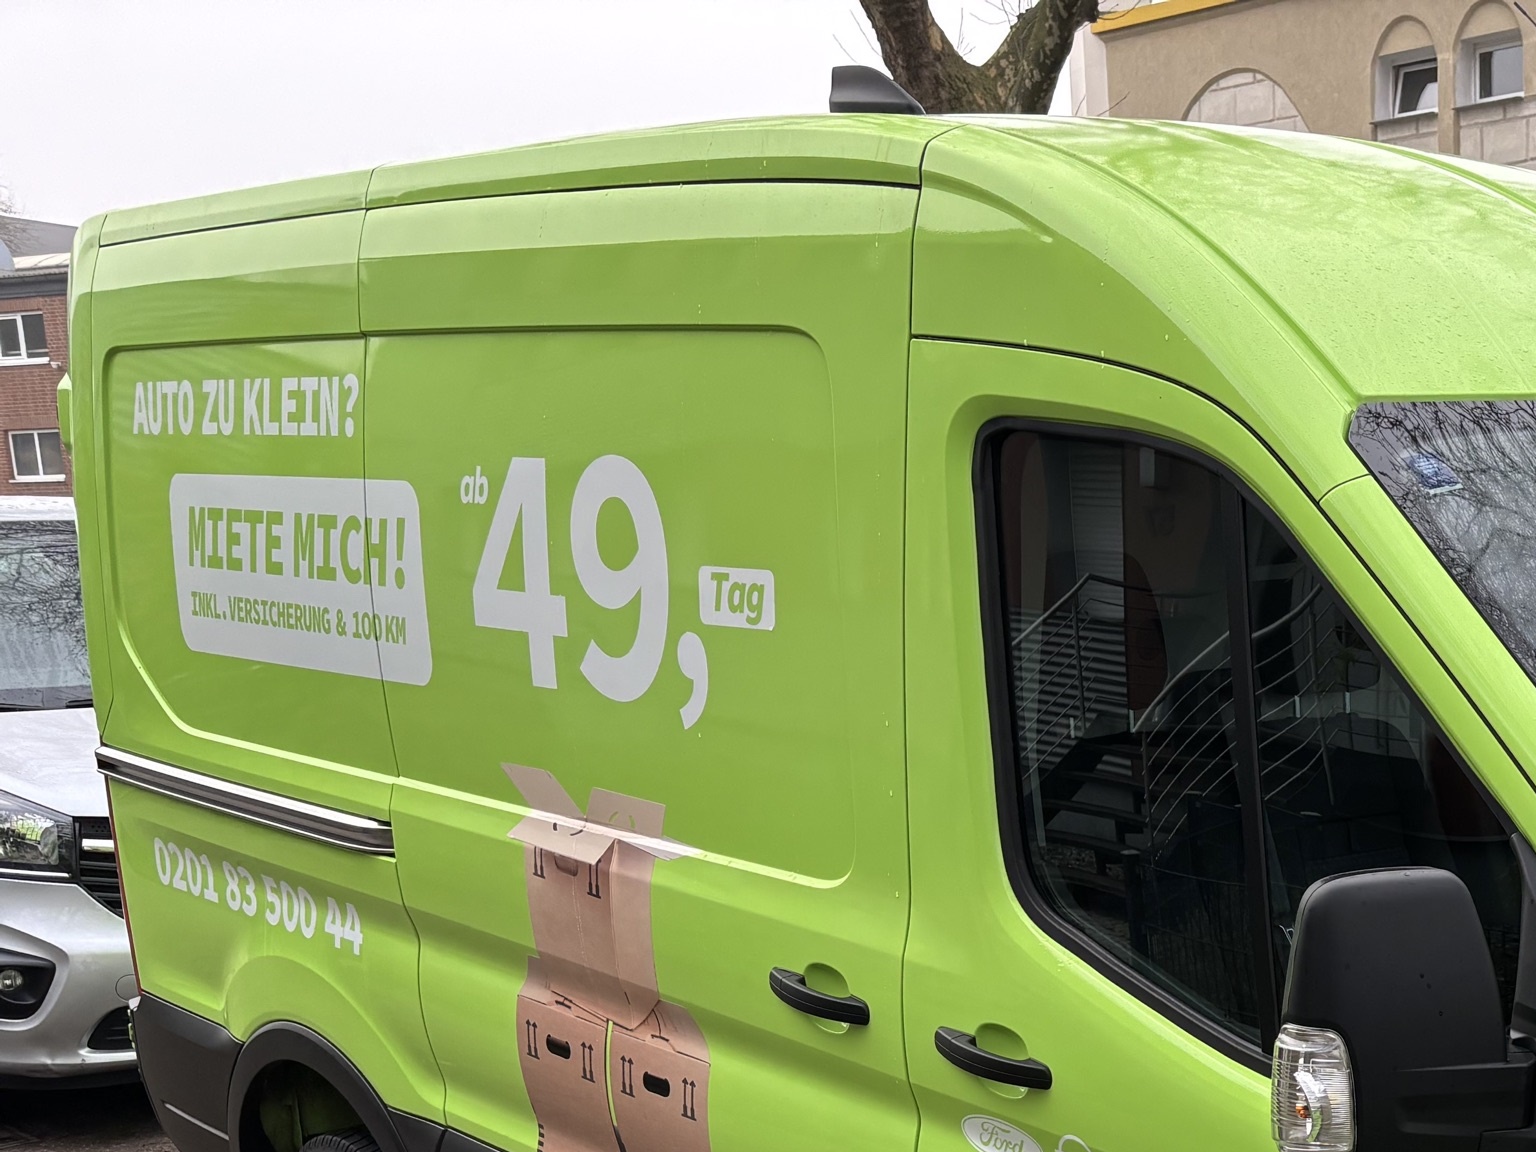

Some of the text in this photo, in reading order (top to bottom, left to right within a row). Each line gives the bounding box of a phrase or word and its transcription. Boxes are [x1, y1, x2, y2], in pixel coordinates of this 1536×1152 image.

[132, 373, 360, 438] AUTO ZU KLEIN?
[188, 505, 406, 590] MIETE MICH!
[459, 465, 489, 505] ab
[710, 572, 765, 626] Tag
[190, 591, 407, 646] INKL. VERSICHERUNG & 100 KM
[152, 836, 364, 956] 0201 83 500 44
